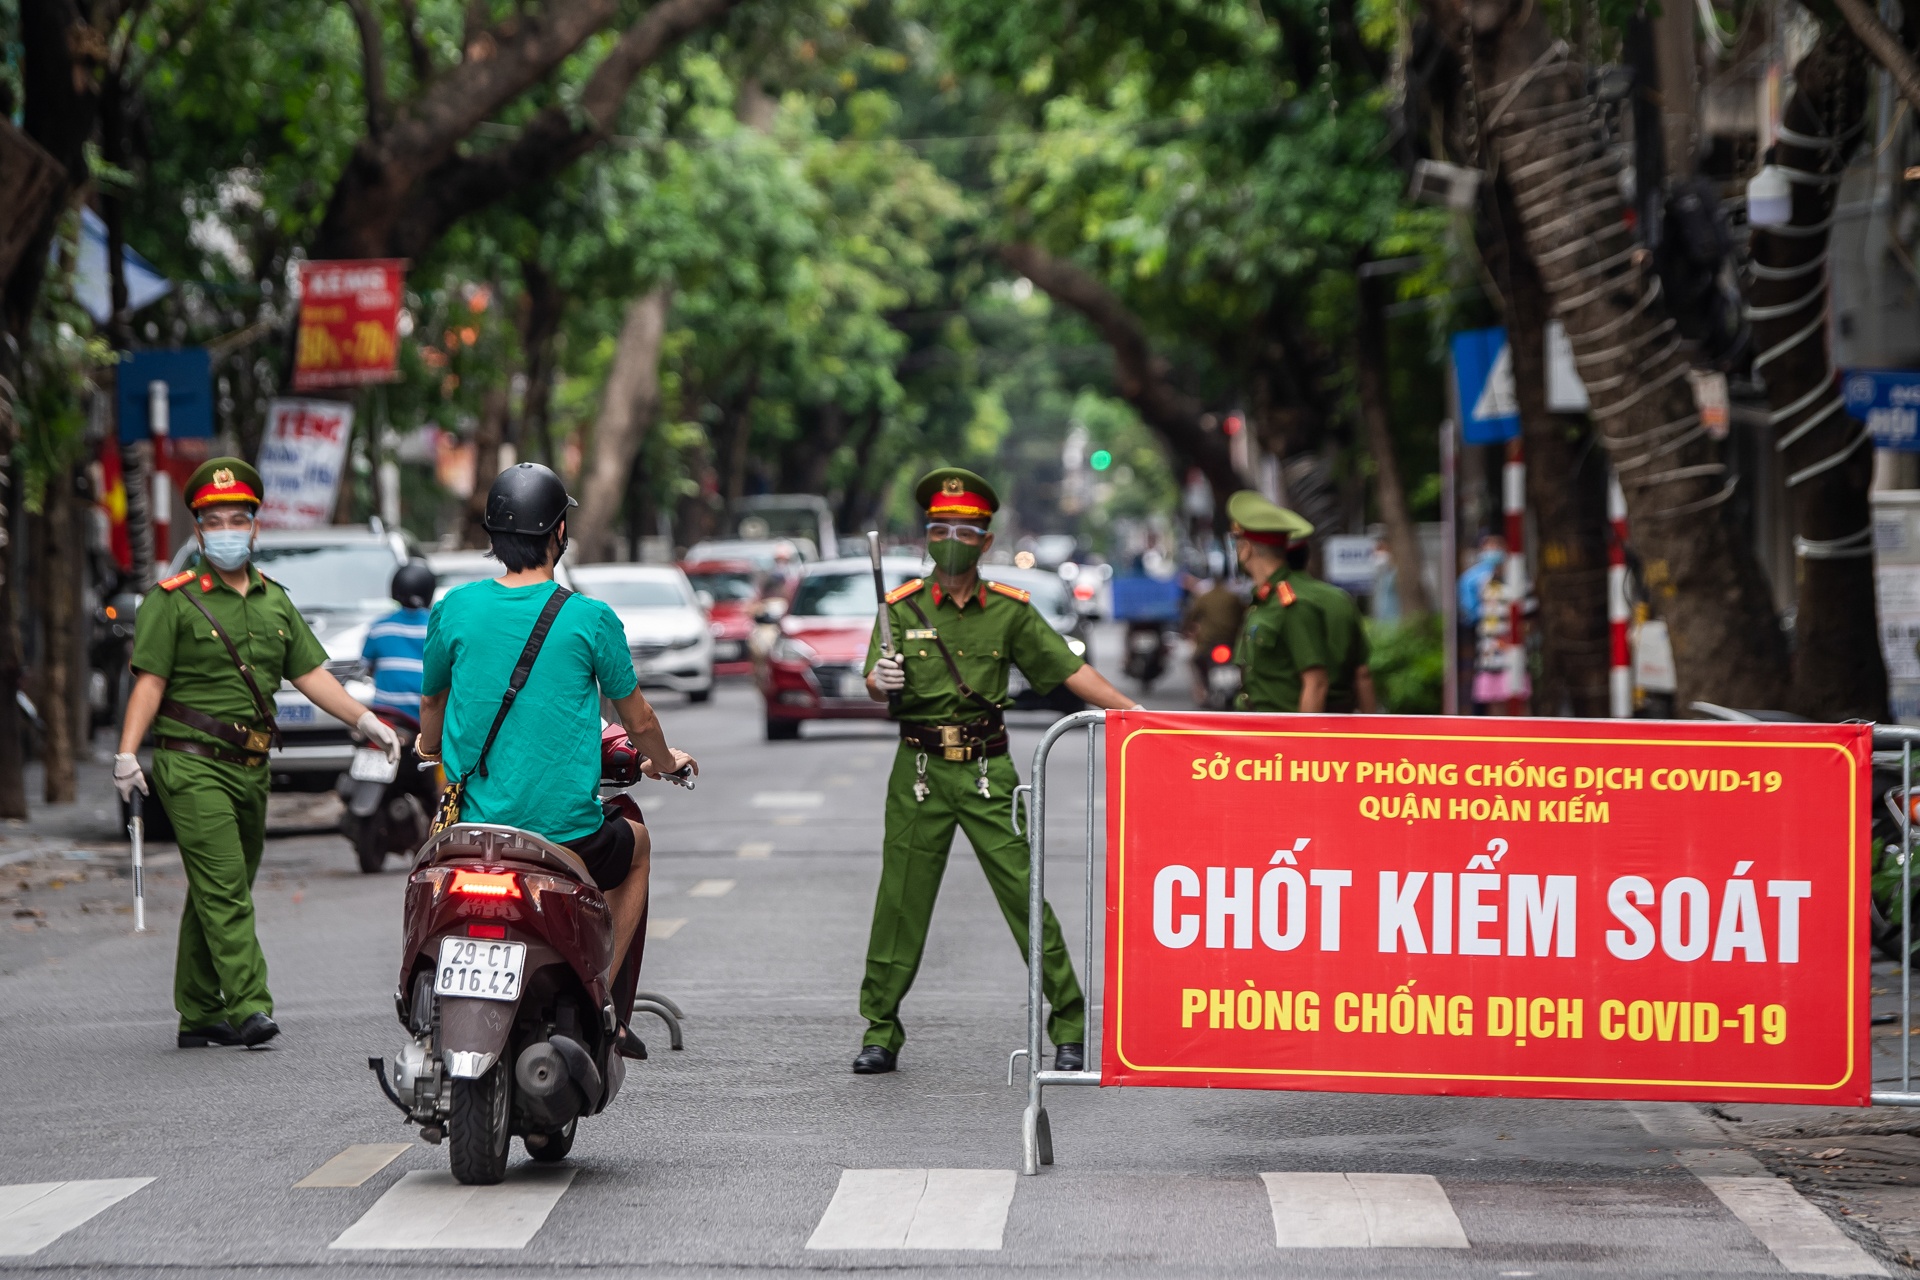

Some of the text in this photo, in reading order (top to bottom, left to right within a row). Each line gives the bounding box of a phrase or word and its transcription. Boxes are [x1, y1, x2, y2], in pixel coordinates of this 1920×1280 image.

[522, 590, 567, 663] COUTURE
[1191, 751, 1783, 796] SỞ CHỈ HUY PHÒNG CHỐNG DỊCH COVID-19
[1358, 792, 1610, 826] QUẬN HOÀN KIẾM
[1152, 837, 1812, 964] CHỐT KIỂM SOÁT
[451, 941, 512, 969] 29-C1
[441, 966, 516, 996] 816.42
[1181, 979, 1787, 1047] PHÒNG CHỐNG DỊCH COVID-19
